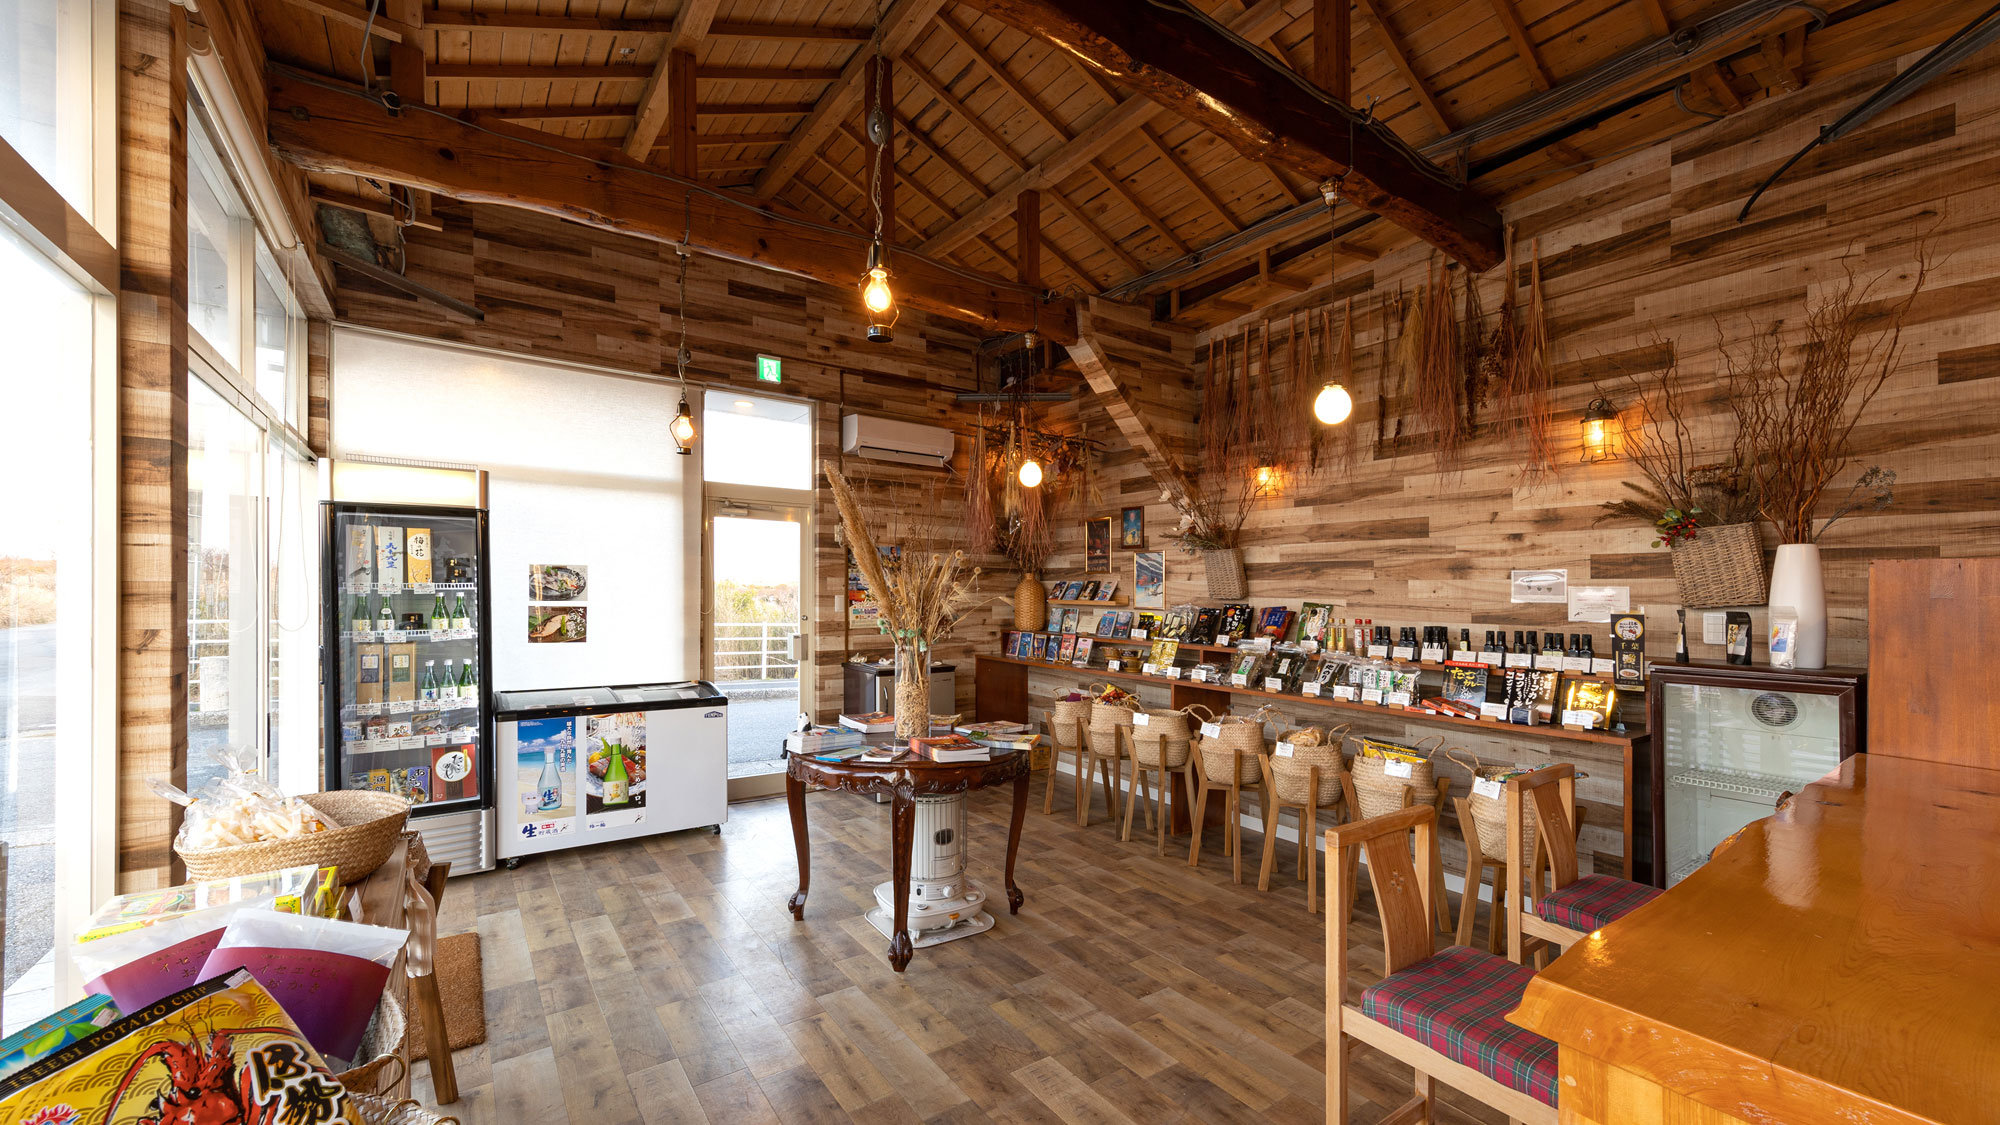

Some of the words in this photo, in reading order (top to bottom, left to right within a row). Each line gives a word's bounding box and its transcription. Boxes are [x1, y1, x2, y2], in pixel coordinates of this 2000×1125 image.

[413, 536, 425, 557] 梅の花
[1450, 667, 1476, 680] たこ
[1463, 679, 1486, 688] カレー
[1572, 700, 1606, 709] 千葉カレー
[543, 789, 554, 801] 生
[522, 823, 538, 839] 生
[8, 1046, 85, 1089] ISEEBI
[90, 1003, 167, 1048] POTATO
[171, 985, 207, 1008] CHIP
